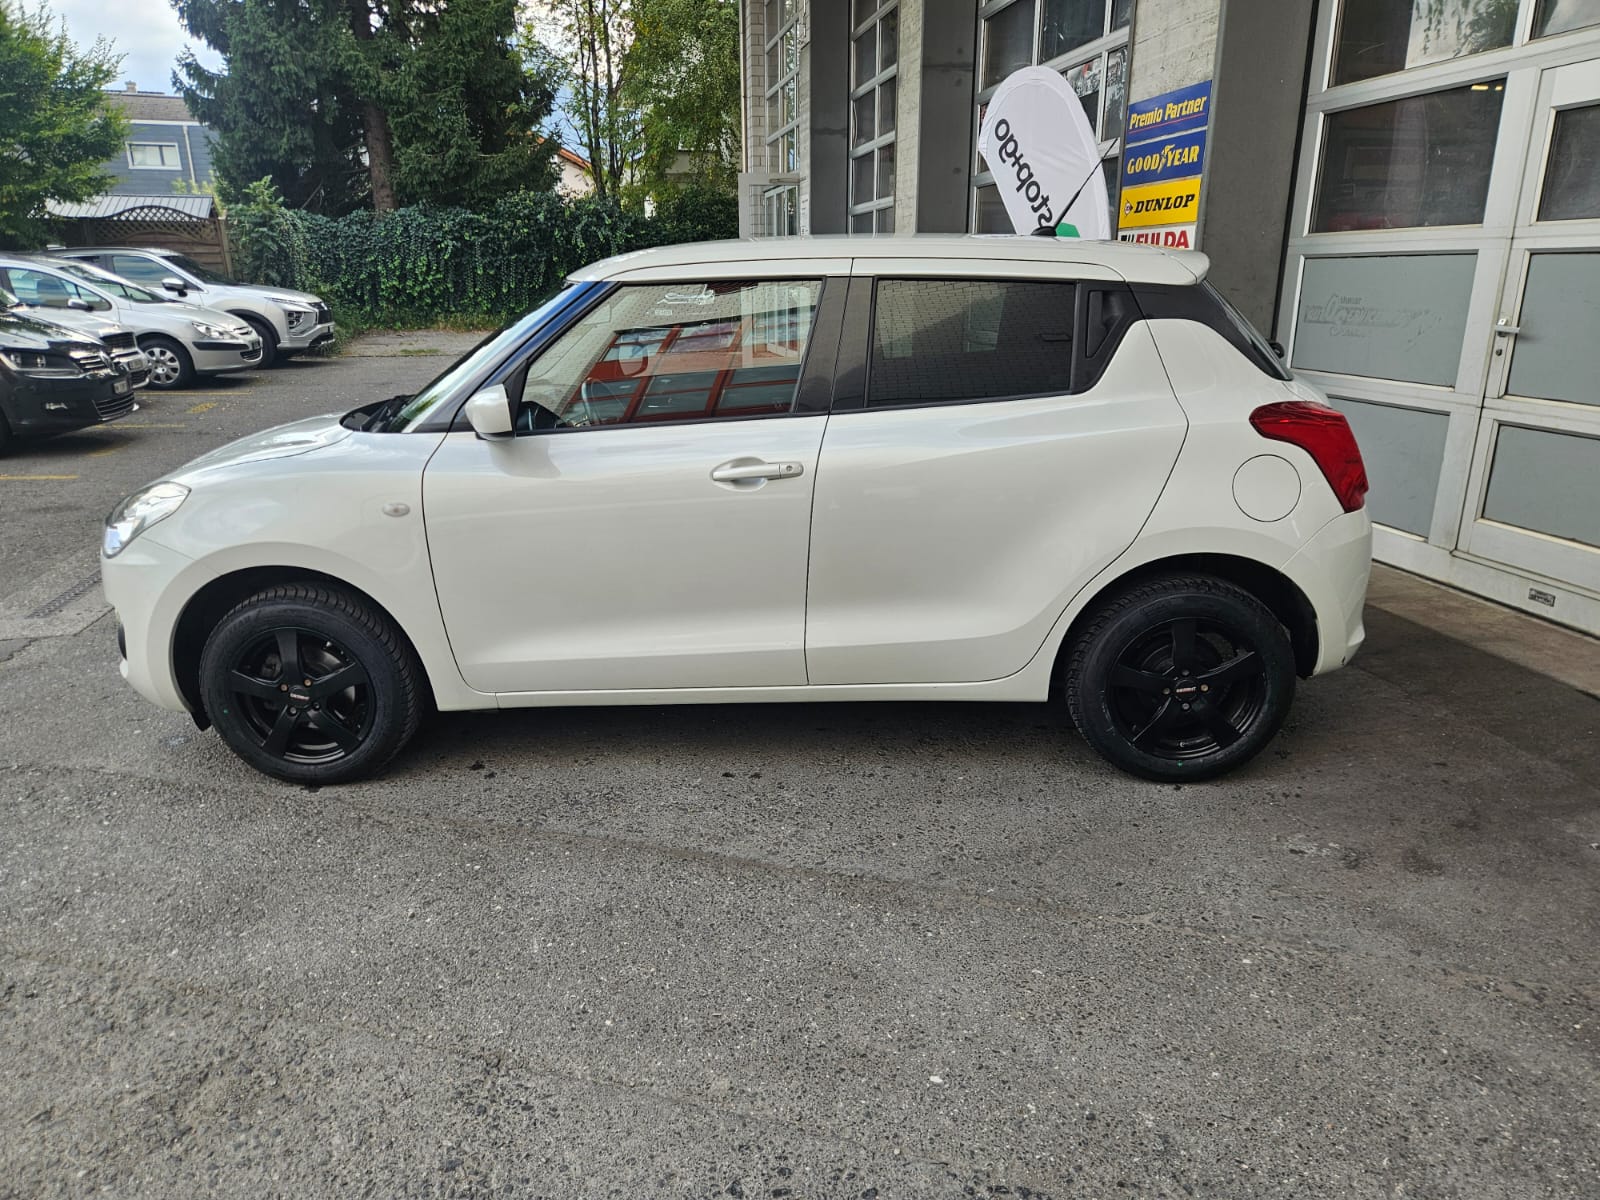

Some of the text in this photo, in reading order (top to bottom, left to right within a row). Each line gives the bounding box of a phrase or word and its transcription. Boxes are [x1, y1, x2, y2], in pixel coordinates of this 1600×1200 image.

[1129, 96, 1207, 130] Premio Partner
[1127, 145, 1200, 175] GOODYEAR
[1134, 194, 1196, 214] DUNLOP
